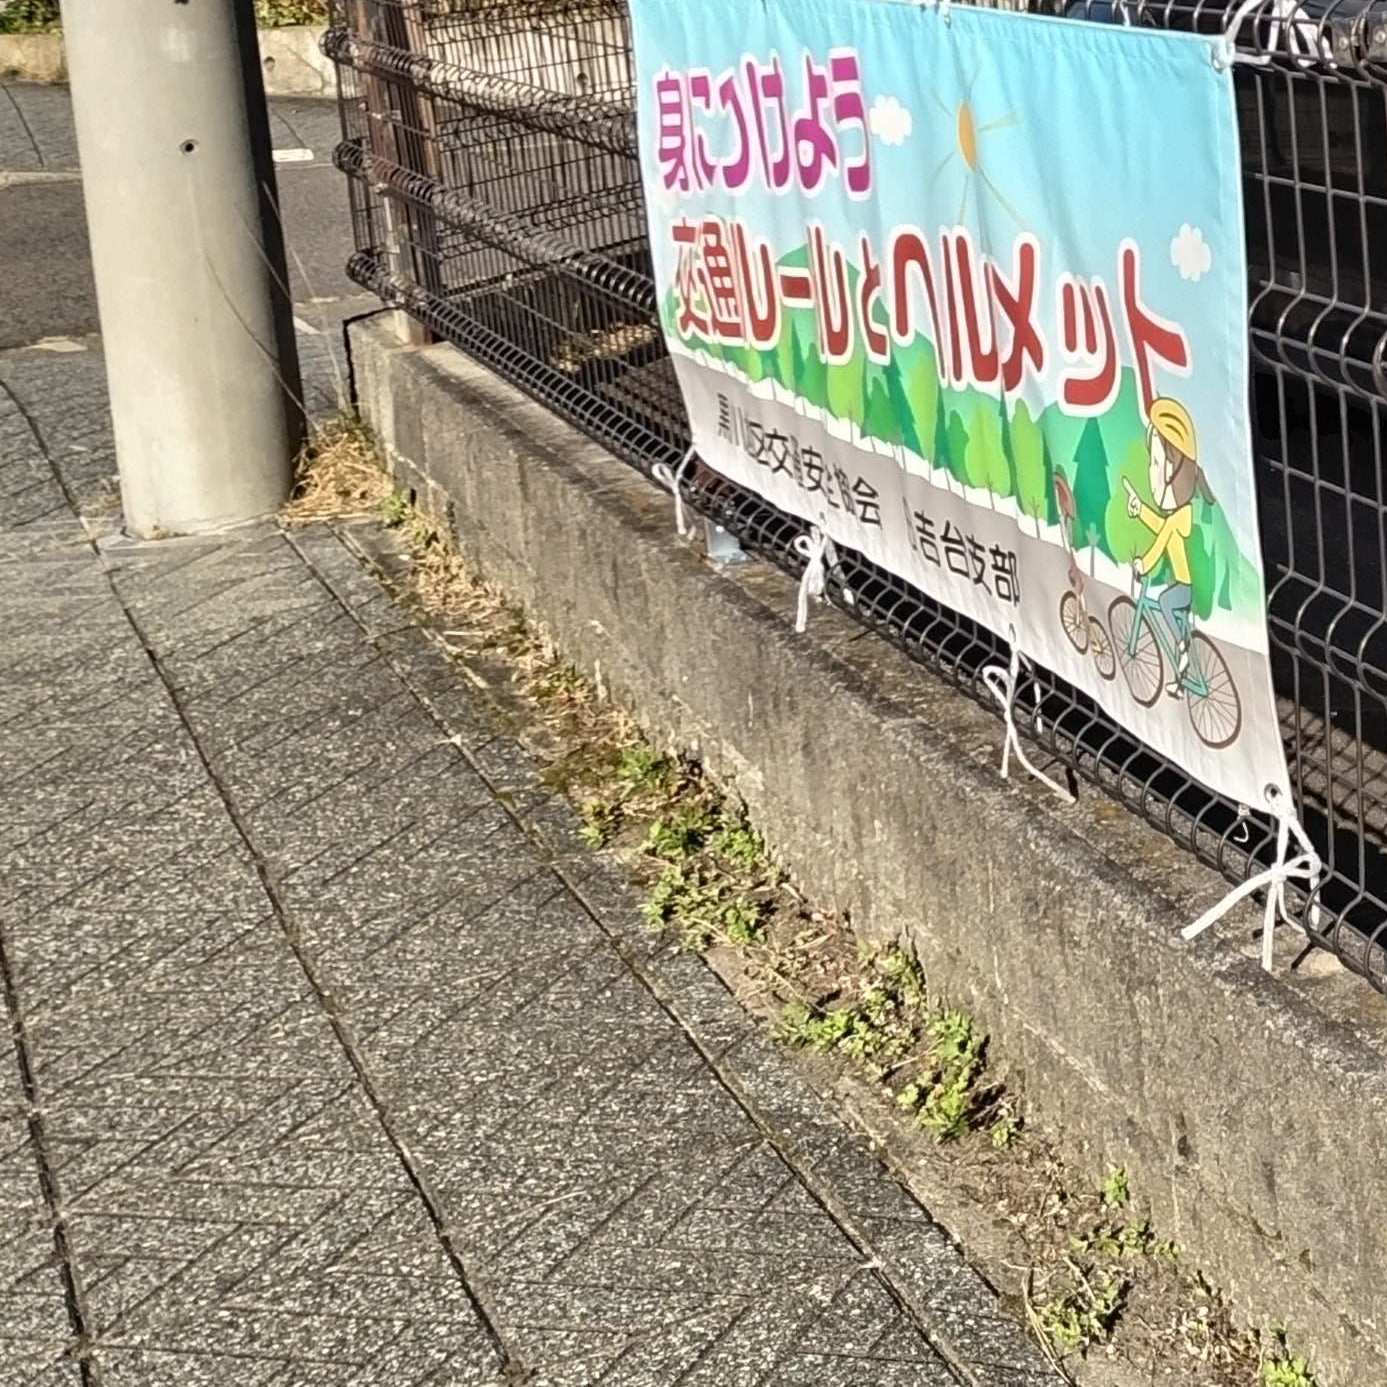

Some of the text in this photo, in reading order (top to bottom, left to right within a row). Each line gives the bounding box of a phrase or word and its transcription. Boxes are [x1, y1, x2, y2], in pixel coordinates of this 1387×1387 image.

[655, 53, 872, 195] 身につけよう
[671, 216, 1189, 416] 交通ルールとヘルメット
[902, 495, 1021, 607] 吉台支部
